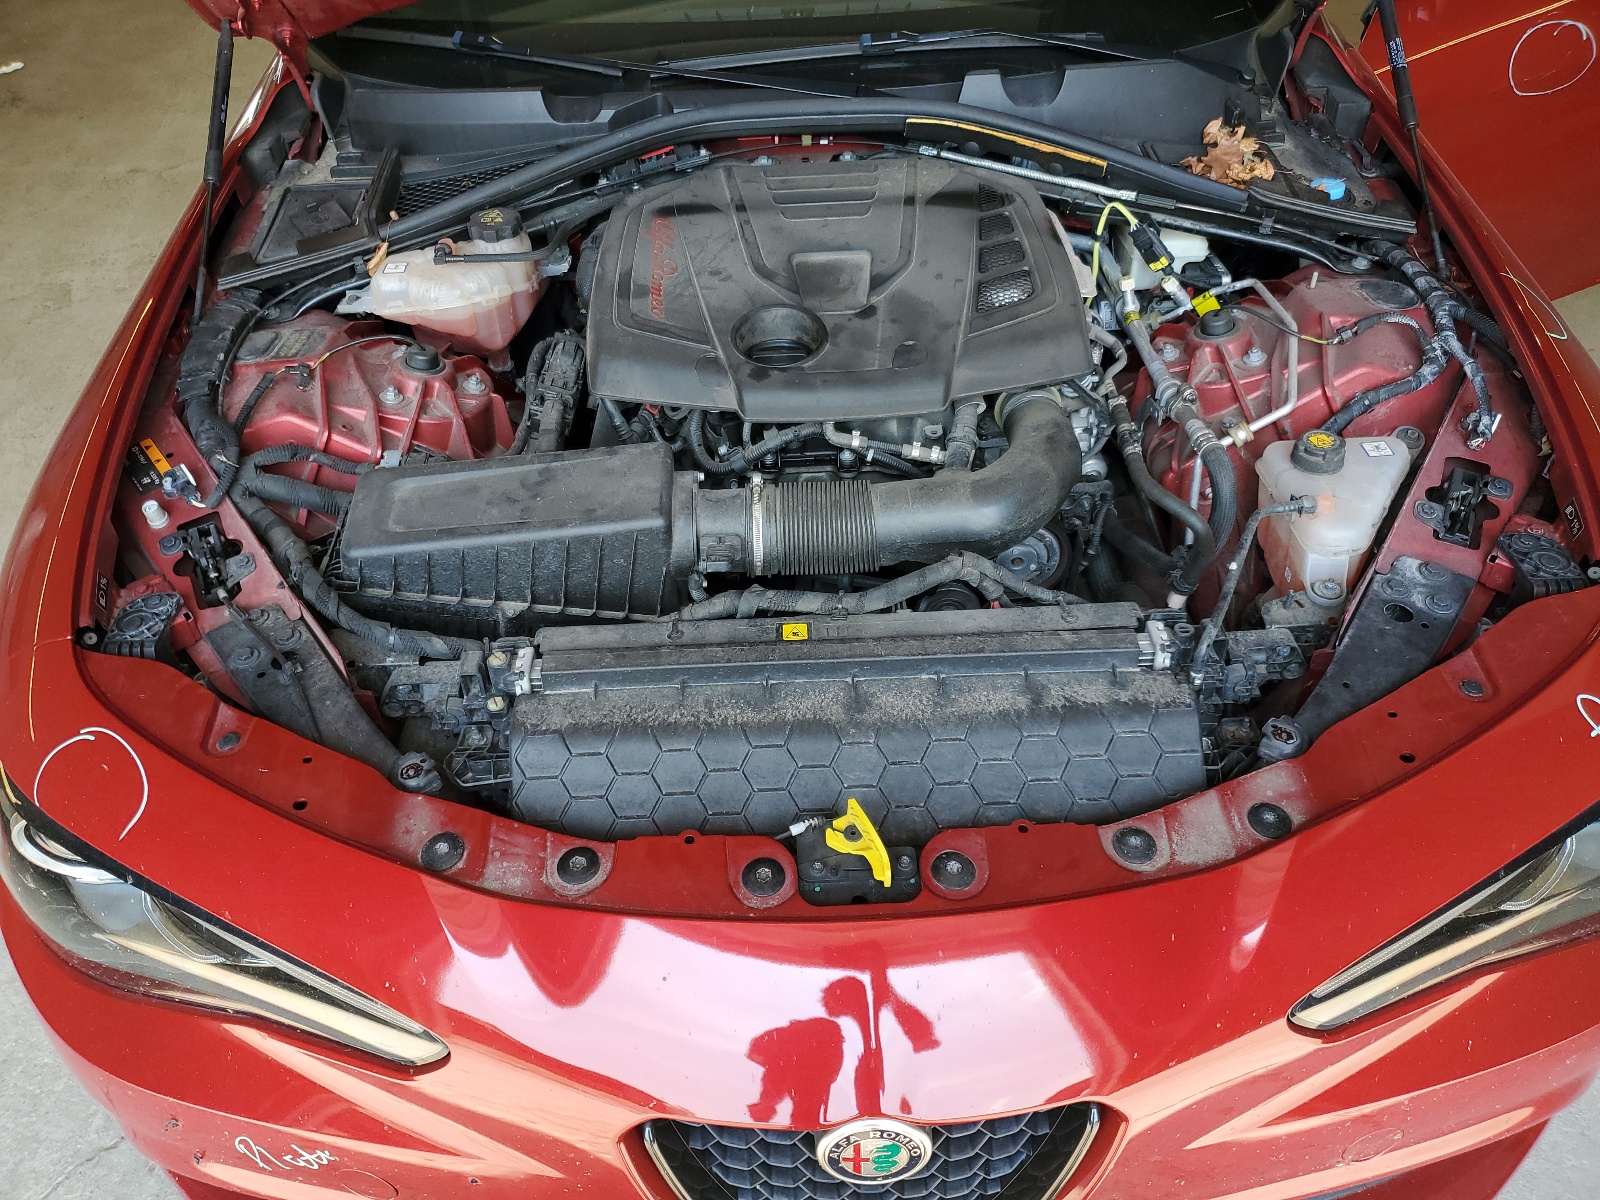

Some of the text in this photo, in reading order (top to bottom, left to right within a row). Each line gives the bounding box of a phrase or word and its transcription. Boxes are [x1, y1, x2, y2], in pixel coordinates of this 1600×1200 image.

[642, 217, 679, 319] Alfa Romeo
[829, 1131, 921, 1160] ALFA ROMEO
